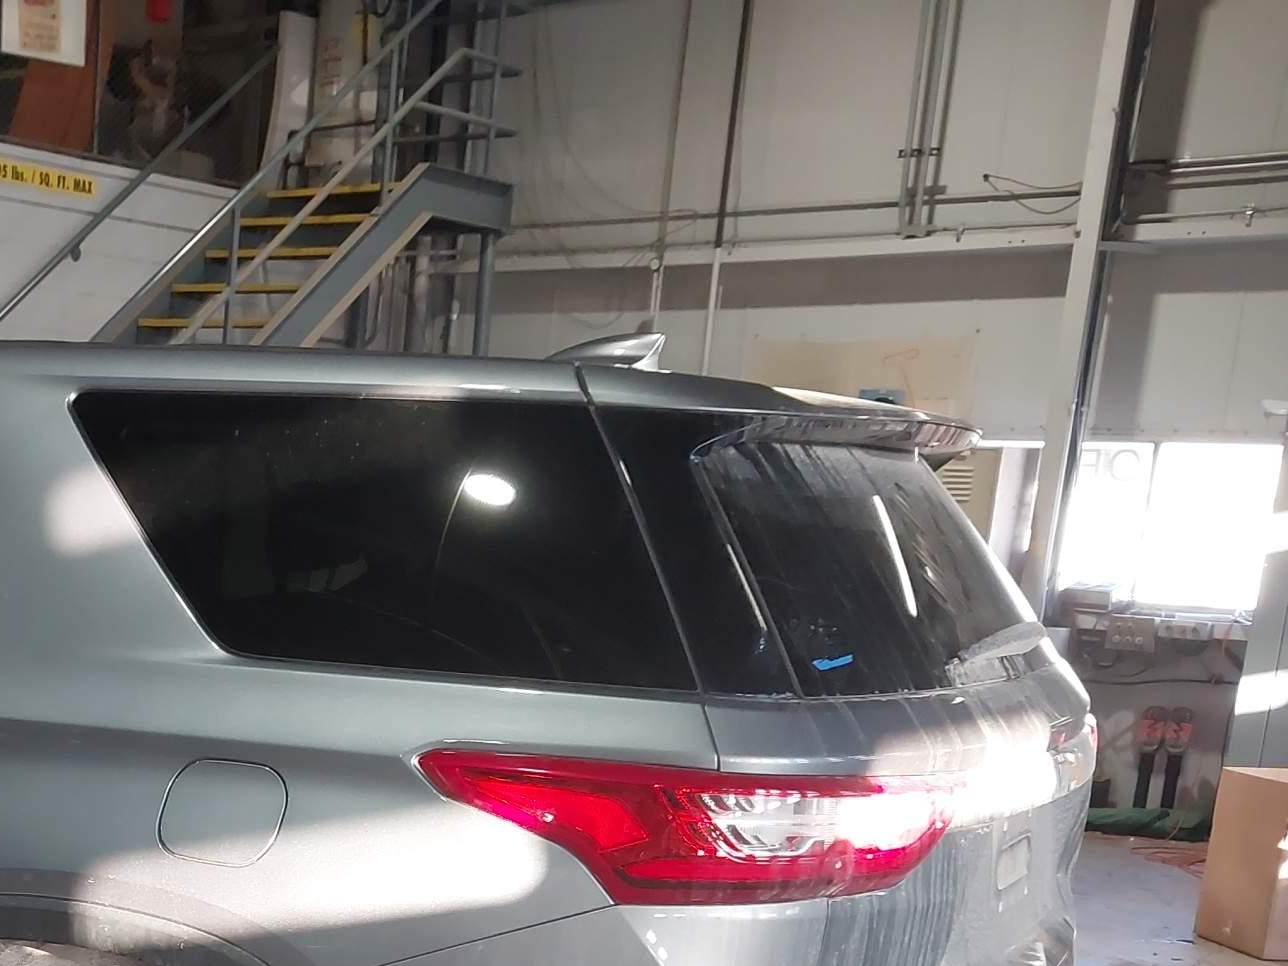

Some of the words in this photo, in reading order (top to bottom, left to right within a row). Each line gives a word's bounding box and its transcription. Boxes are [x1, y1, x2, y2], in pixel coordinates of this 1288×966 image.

[11, 165, 28, 182] lbs.
[39, 171, 53, 188] SQ.
[57, 175, 70, 190] FT.
[73, 177, 93, 194] MAX
